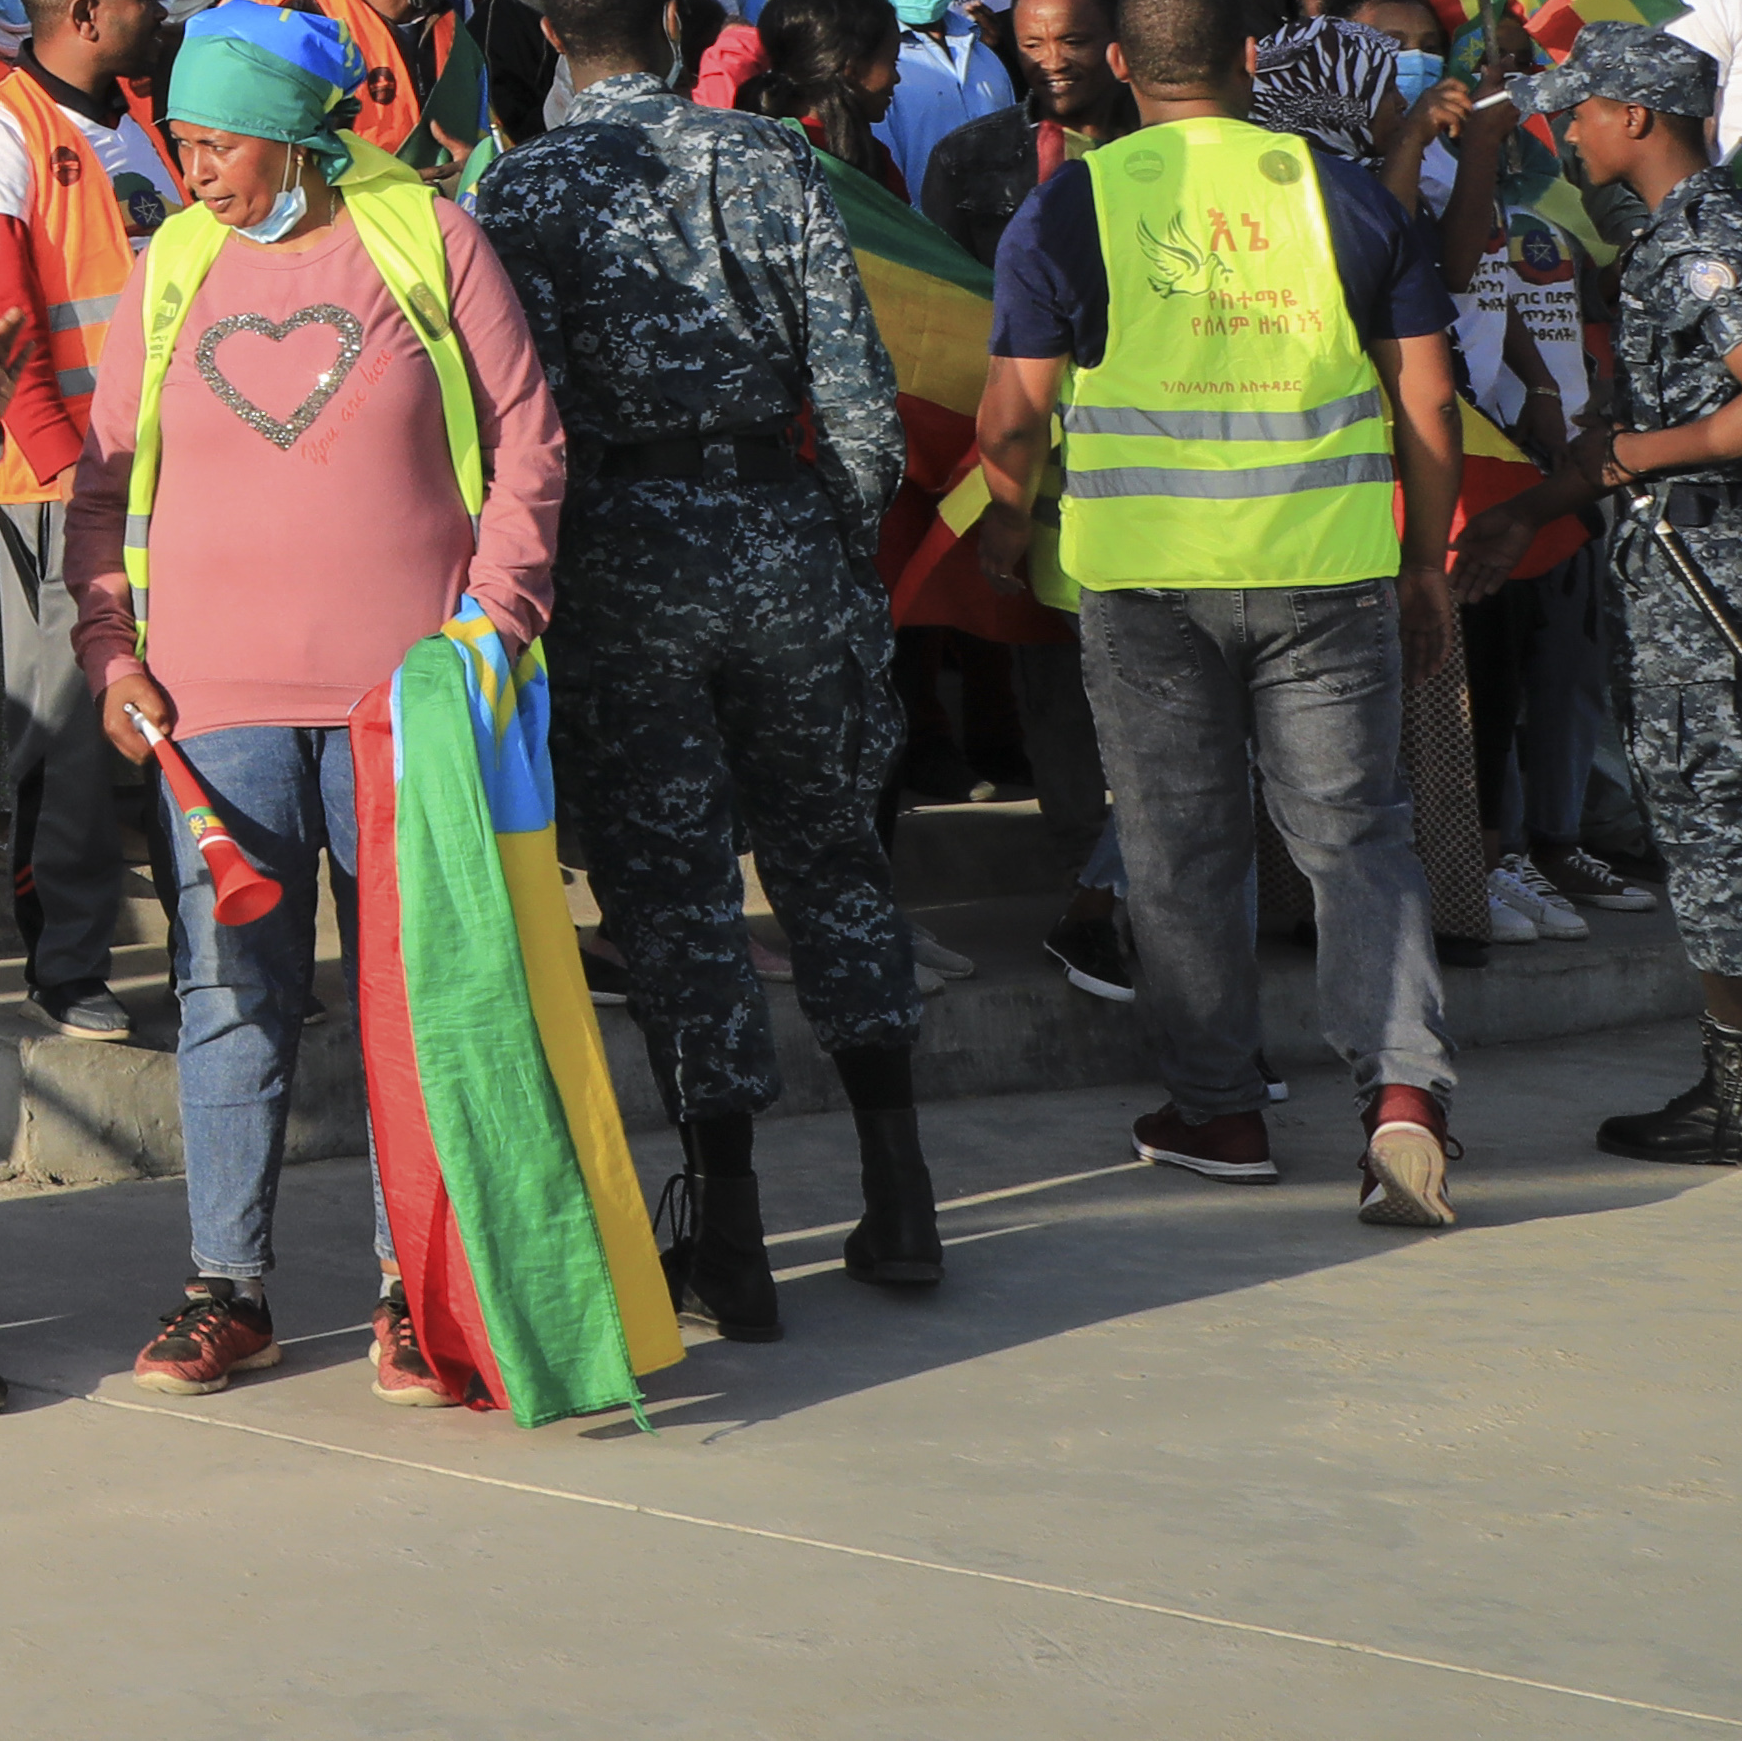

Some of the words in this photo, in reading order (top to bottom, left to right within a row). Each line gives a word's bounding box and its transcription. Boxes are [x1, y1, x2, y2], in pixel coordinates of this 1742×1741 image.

[1207, 207, 1270, 252] እኔ
[1191, 315, 1250, 337] የሰላም
[1258, 314, 1290, 335] ዘብ
